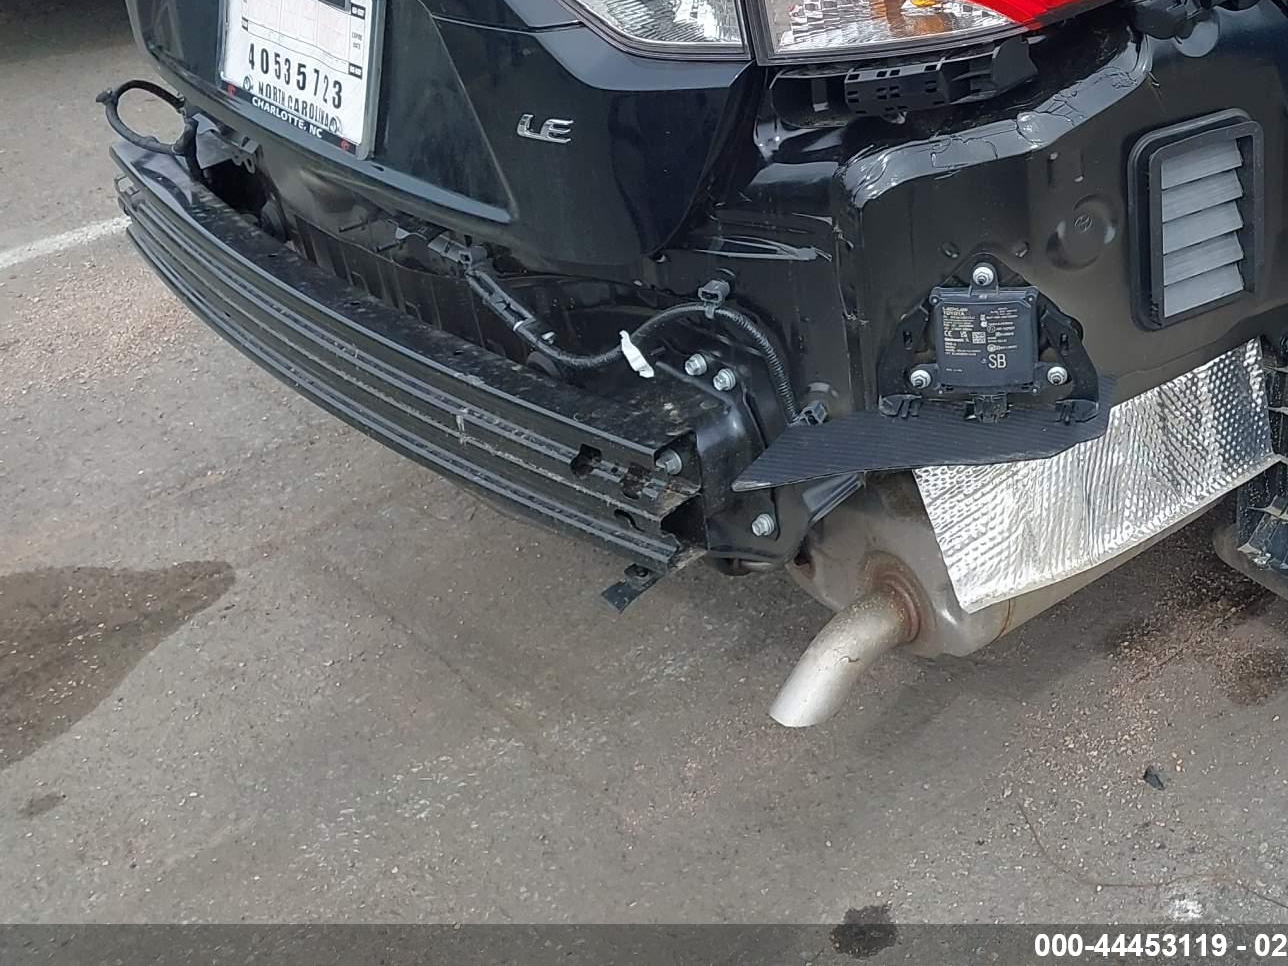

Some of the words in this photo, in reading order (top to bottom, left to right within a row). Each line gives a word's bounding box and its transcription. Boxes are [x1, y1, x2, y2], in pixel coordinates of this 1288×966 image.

[251, 95, 307, 131] CHARLOTTE,
[308, 125, 323, 139] NC
[258, 80, 286, 107] NORTH
[287, 94, 329, 129] CAROLINA
[516, 113, 574, 144] LE
[988, 353, 1007, 369] SB
